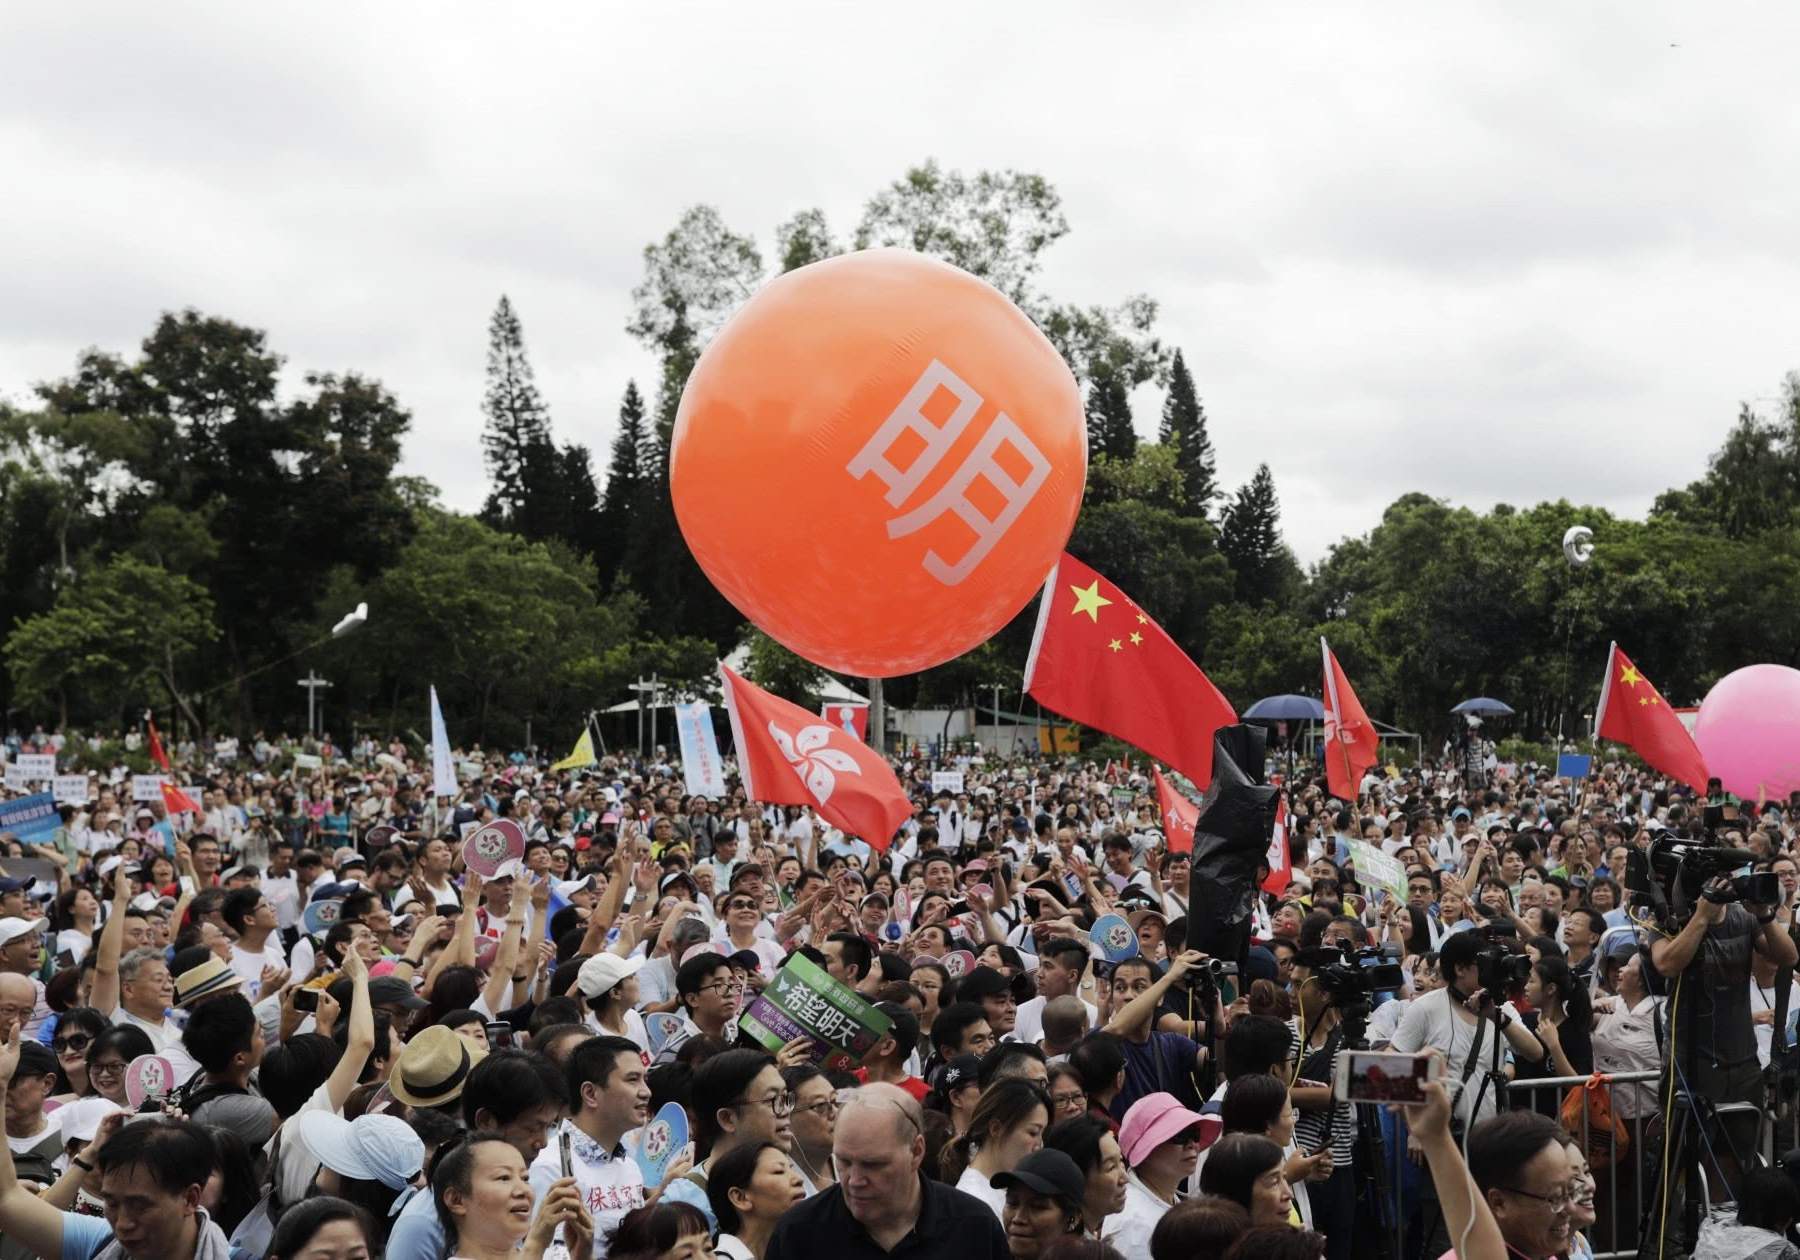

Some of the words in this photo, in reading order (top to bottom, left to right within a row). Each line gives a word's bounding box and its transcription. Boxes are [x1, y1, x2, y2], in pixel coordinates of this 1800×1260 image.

[845, 358, 1052, 586] 明
[773, 1022, 794, 1041] Peace
[784, 981, 861, 1048] 希望明天
